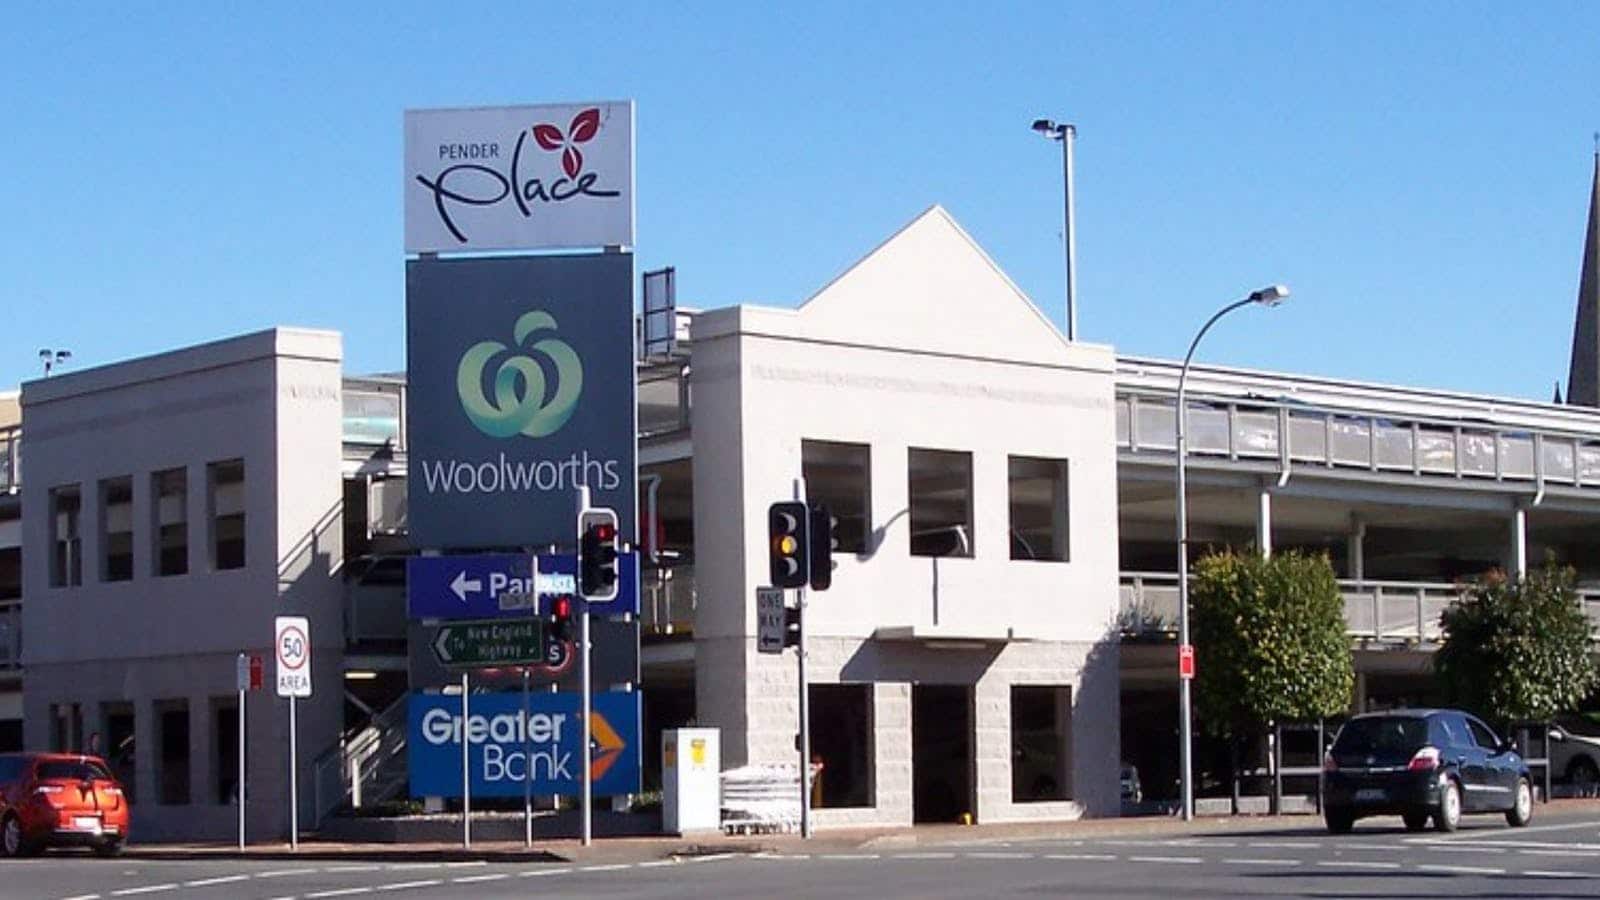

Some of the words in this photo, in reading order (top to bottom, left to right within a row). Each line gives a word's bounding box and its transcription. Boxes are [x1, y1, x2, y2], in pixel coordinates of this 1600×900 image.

[439, 143, 500, 159] PENDER
[422, 450, 620, 493] Woolworths
[283, 637, 302, 658] 50
[279, 676, 308, 690] AREA
[422, 708, 566, 744] Greater
